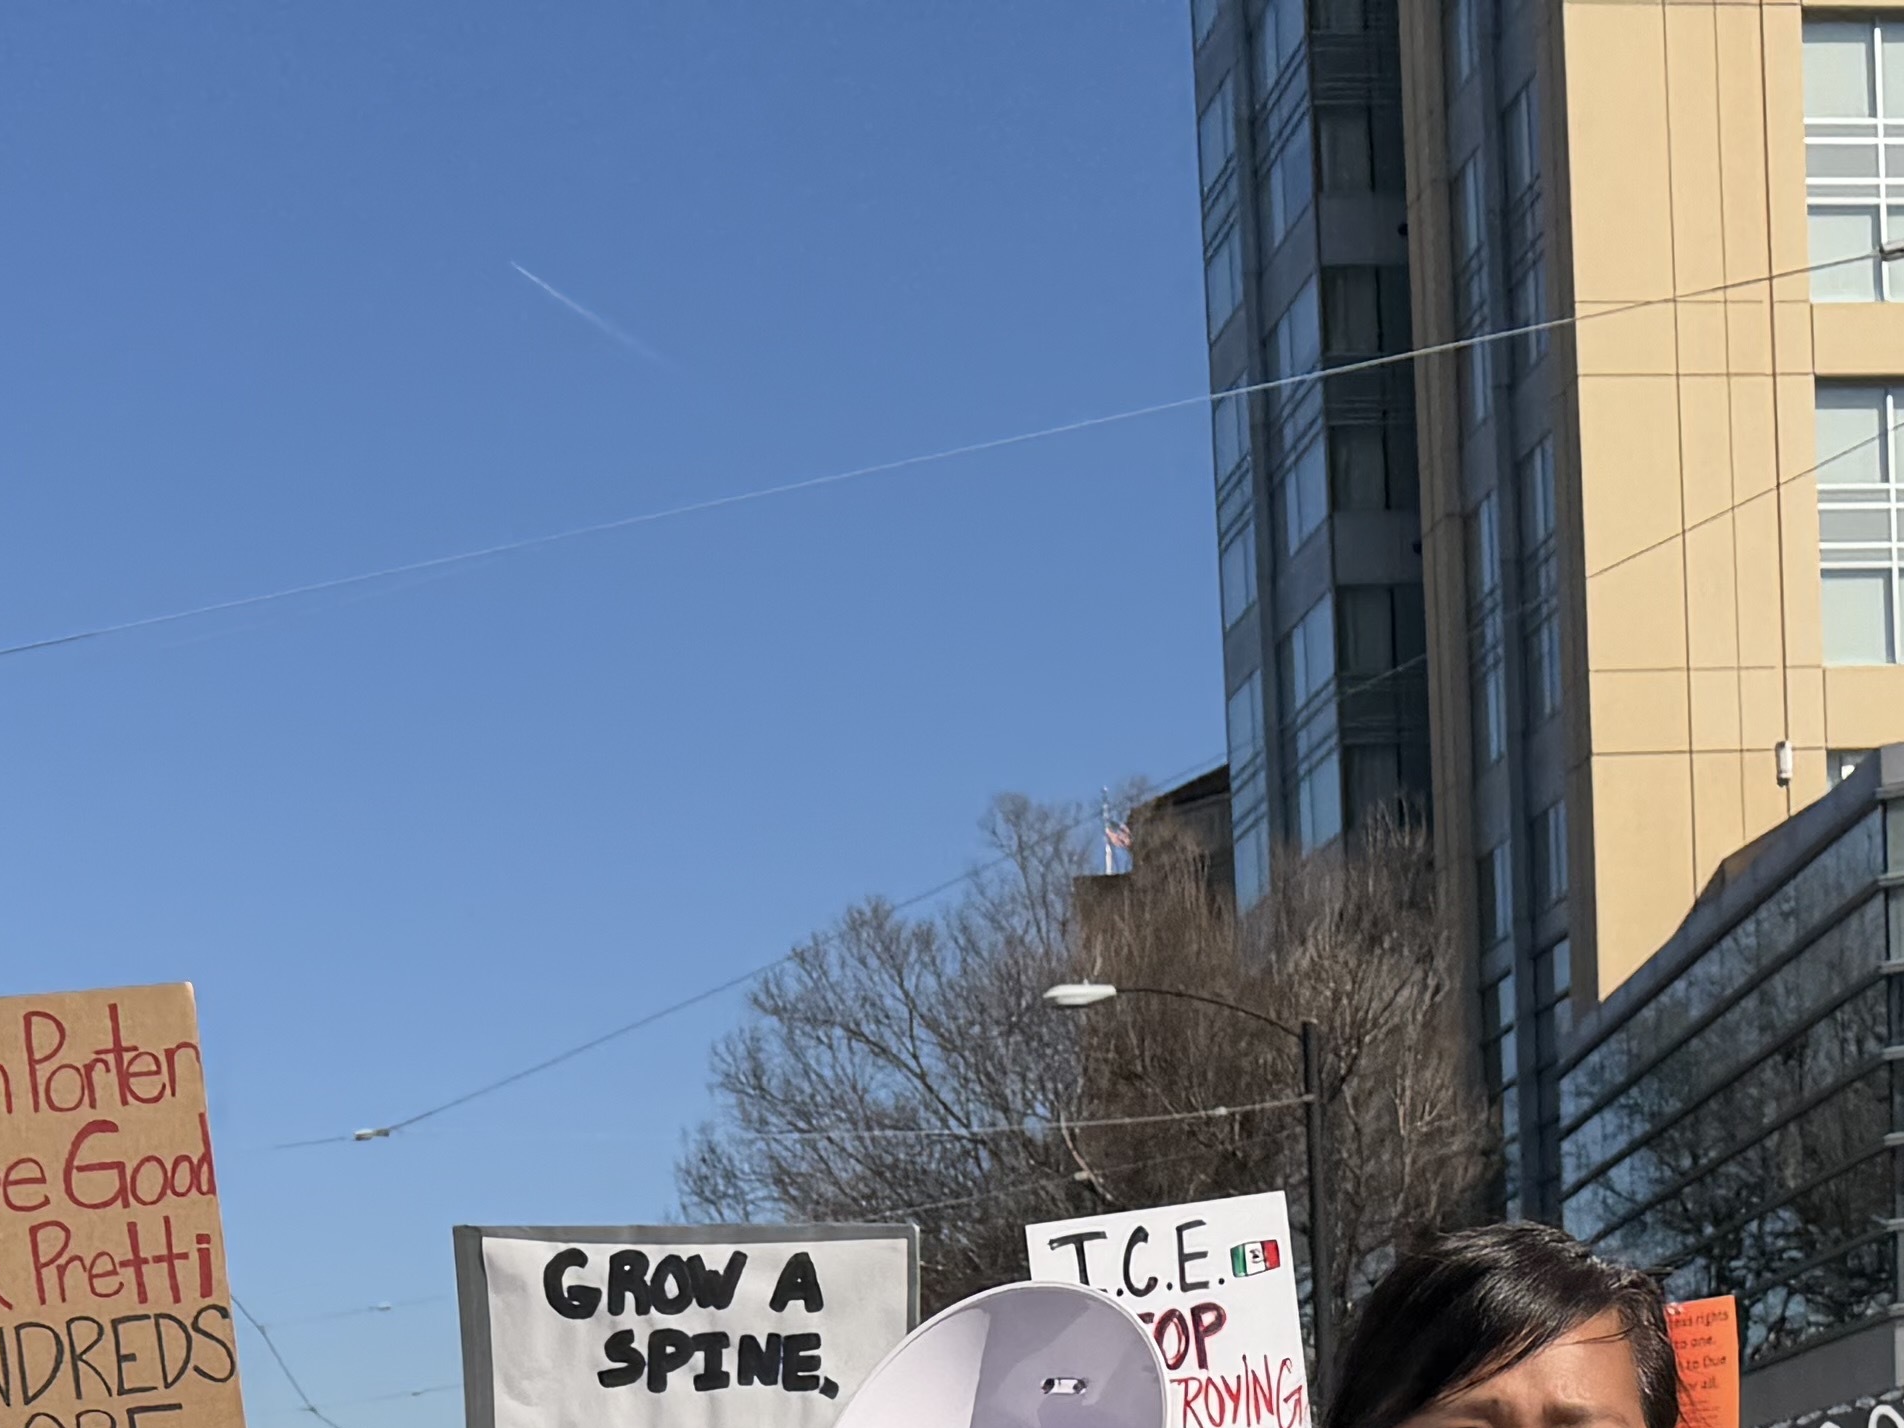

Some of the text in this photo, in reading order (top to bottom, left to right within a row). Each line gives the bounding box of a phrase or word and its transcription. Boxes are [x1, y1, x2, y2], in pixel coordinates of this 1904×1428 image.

[24, 1003, 201, 1113] Porter
[63, 1112, 216, 1210] Good
[29, 1216, 213, 1305] Pretti
[543, 1248, 824, 1320] GROW A
